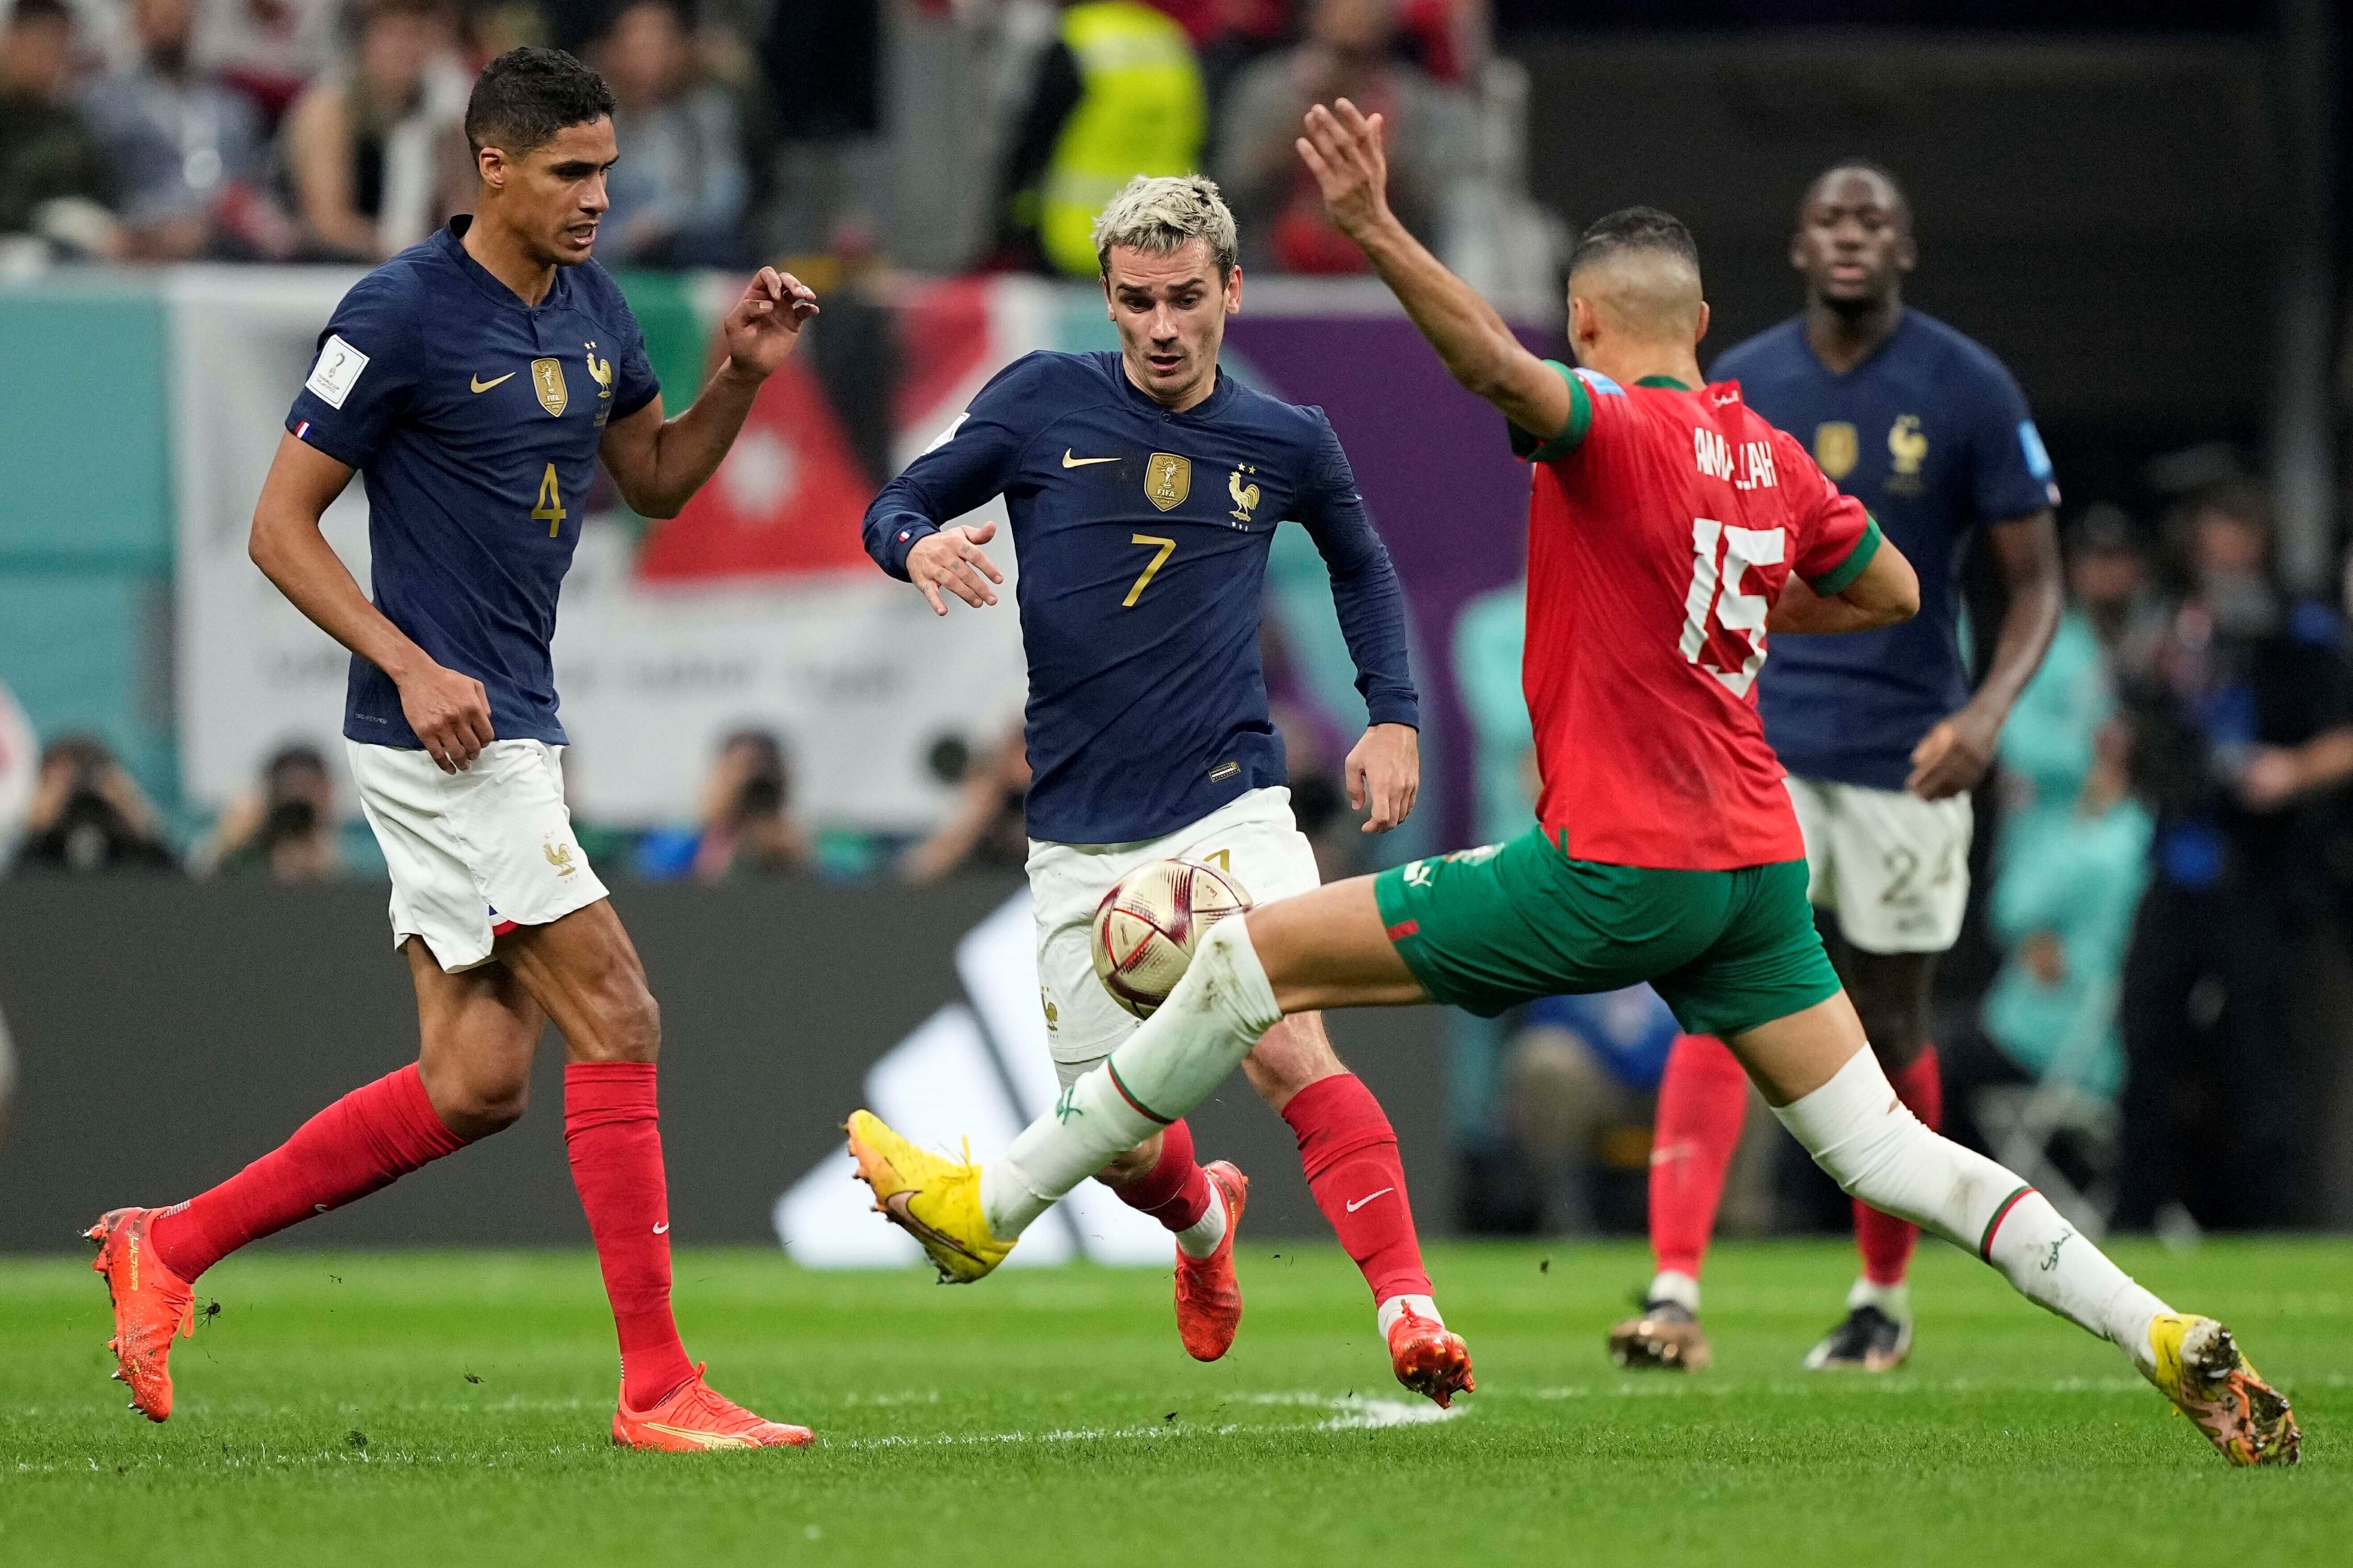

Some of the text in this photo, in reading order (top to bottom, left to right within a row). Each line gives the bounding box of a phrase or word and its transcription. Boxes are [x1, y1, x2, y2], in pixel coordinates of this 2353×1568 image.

[531, 462, 566, 537] 4
[1157, 488, 1175, 498] FIFA
[1122, 533, 1176, 606] 7
[1679, 517, 1785, 699] 15
